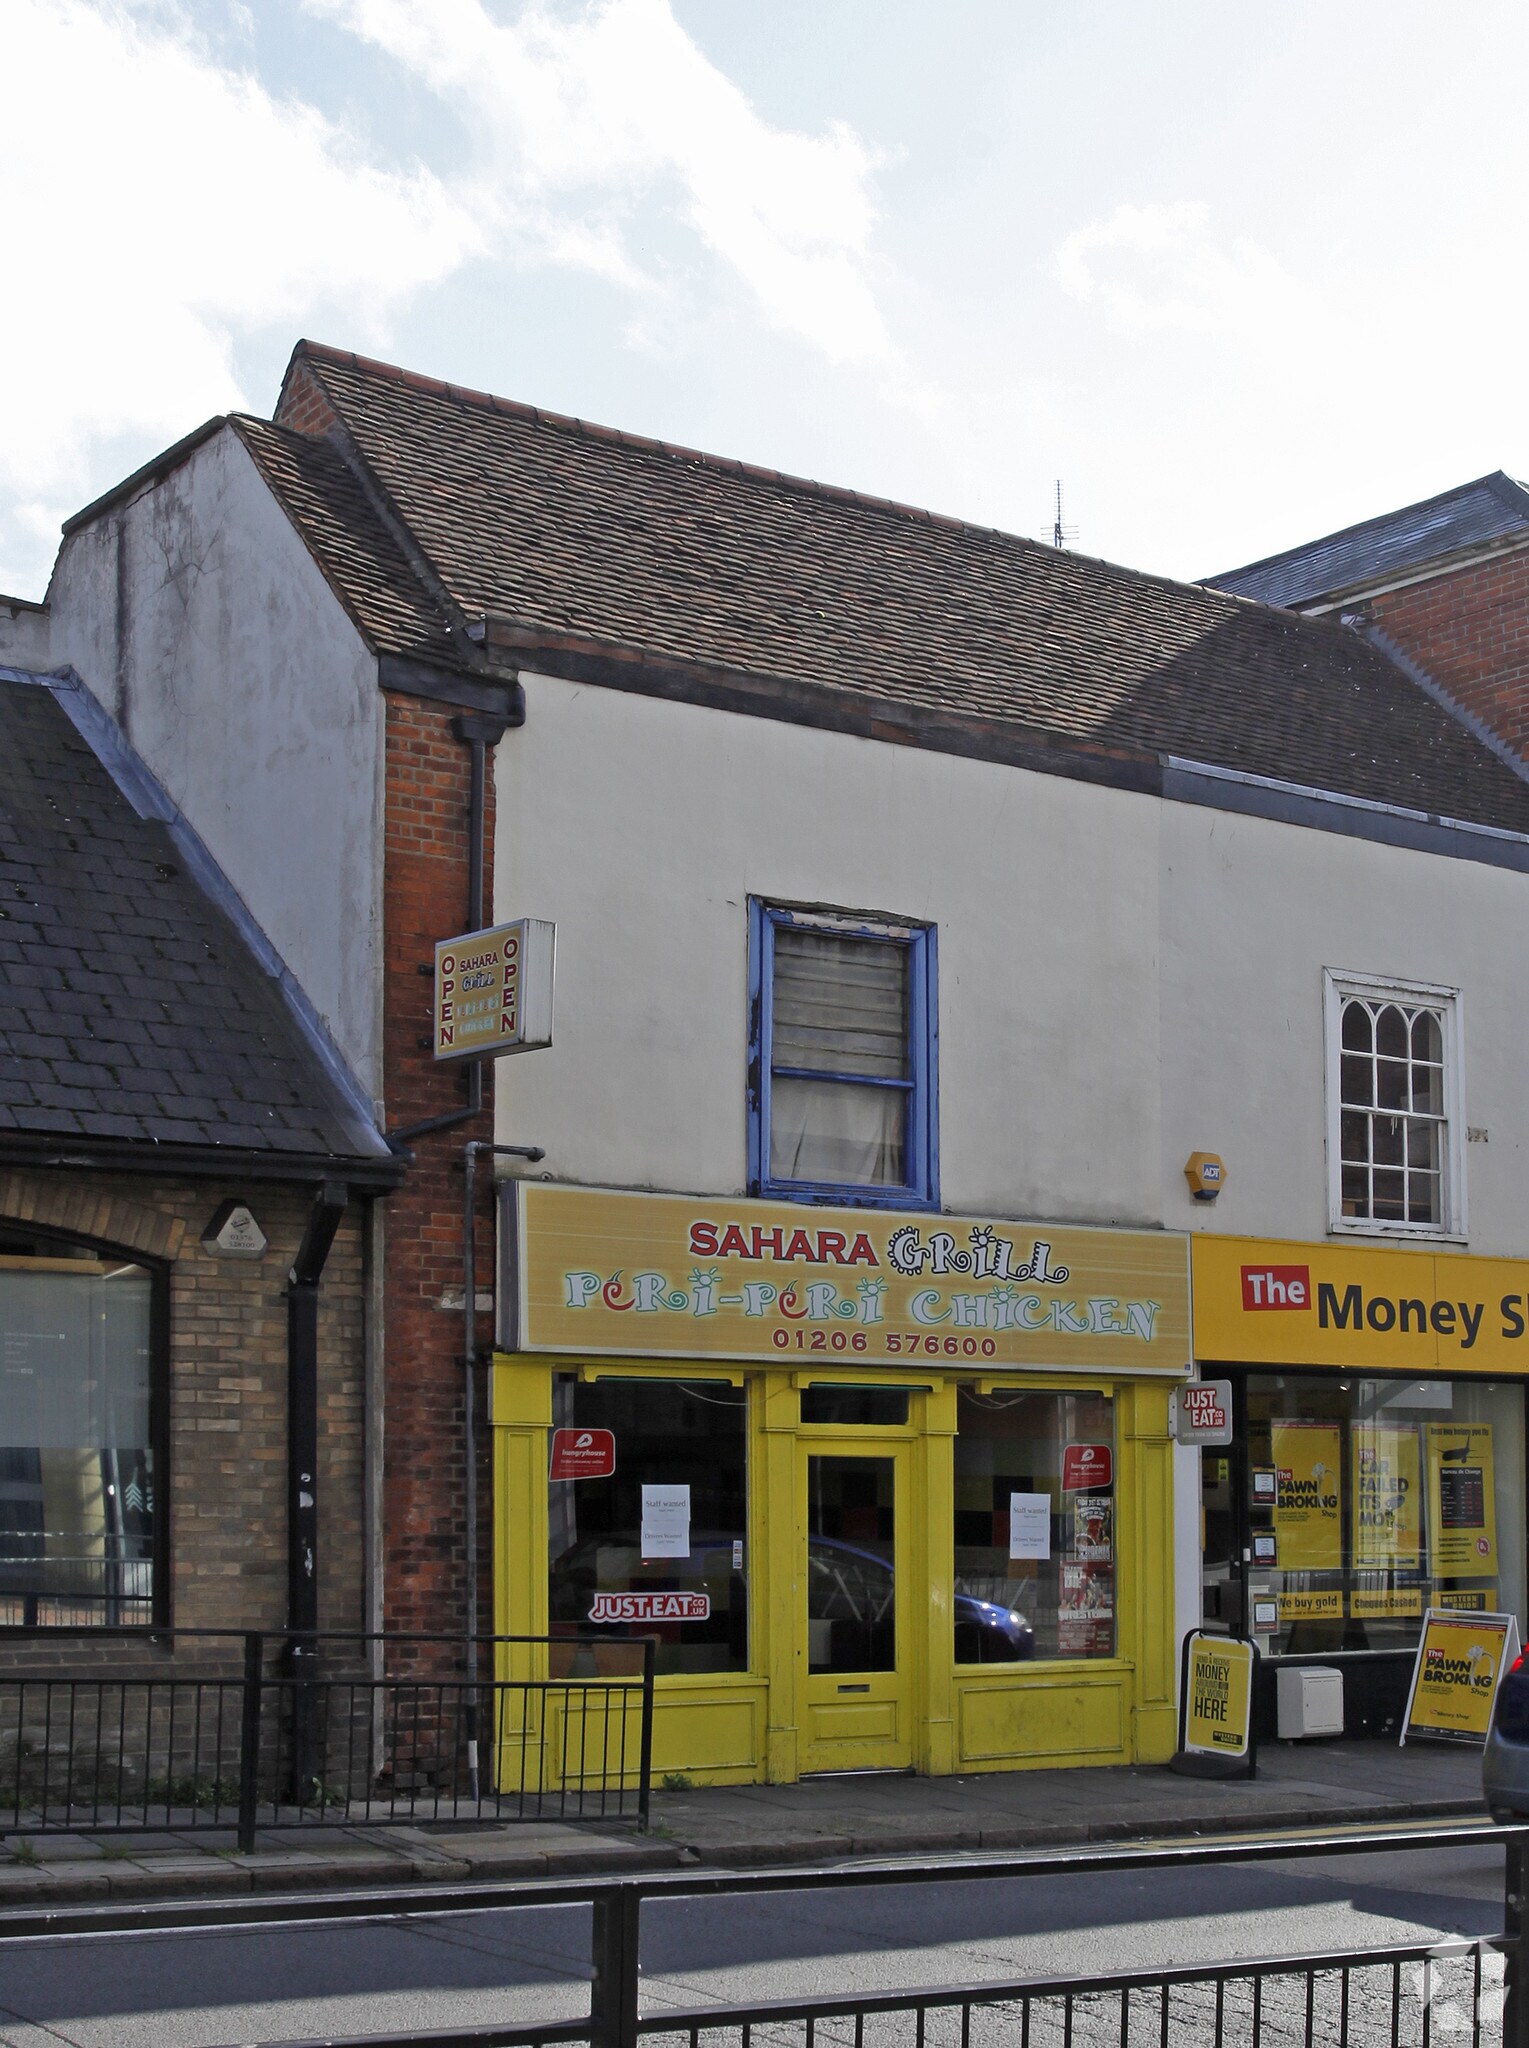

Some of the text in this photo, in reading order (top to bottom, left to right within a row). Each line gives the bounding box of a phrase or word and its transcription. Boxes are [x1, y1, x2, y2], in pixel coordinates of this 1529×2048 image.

[460, 952, 499, 972] SAHARA
[501, 939, 518, 1032] OPEN
[441, 956, 455, 1046] OPEN
[1204, 1167, 1220, 1178] ADT
[689, 1222, 879, 1266] SAHARA
[1247, 1271, 1529, 1349] The Money S
[772, 1328, 997, 1358] 01206 576600
[1184, 1390, 1216, 1409] JUST
[1192, 1409, 1216, 1426] EAT
[1359, 1451, 1374, 1459] The
[1277, 1471, 1292, 1480] The
[1278, 1480, 1318, 1494] PAWN
[1360, 1477, 1409, 1493] FAILED
[1277, 1495, 1338, 1509] BROKING
[1360, 1494, 1382, 1510] ITS
[1321, 1510, 1338, 1520] Shop
[594, 1597, 648, 1618] JUST
[652, 1596, 693, 1616] EAT
[1278, 1595, 1338, 1609] We buy gold
[1427, 1649, 1443, 1658] The
[1195, 1663, 1230, 1682] MONEY
[1425, 1659, 1472, 1673] PAWN
[1423, 1669, 1493, 1688] BROKING
[1471, 1688, 1489, 1698] Shop
[1194, 1696, 1228, 1721] HERE
